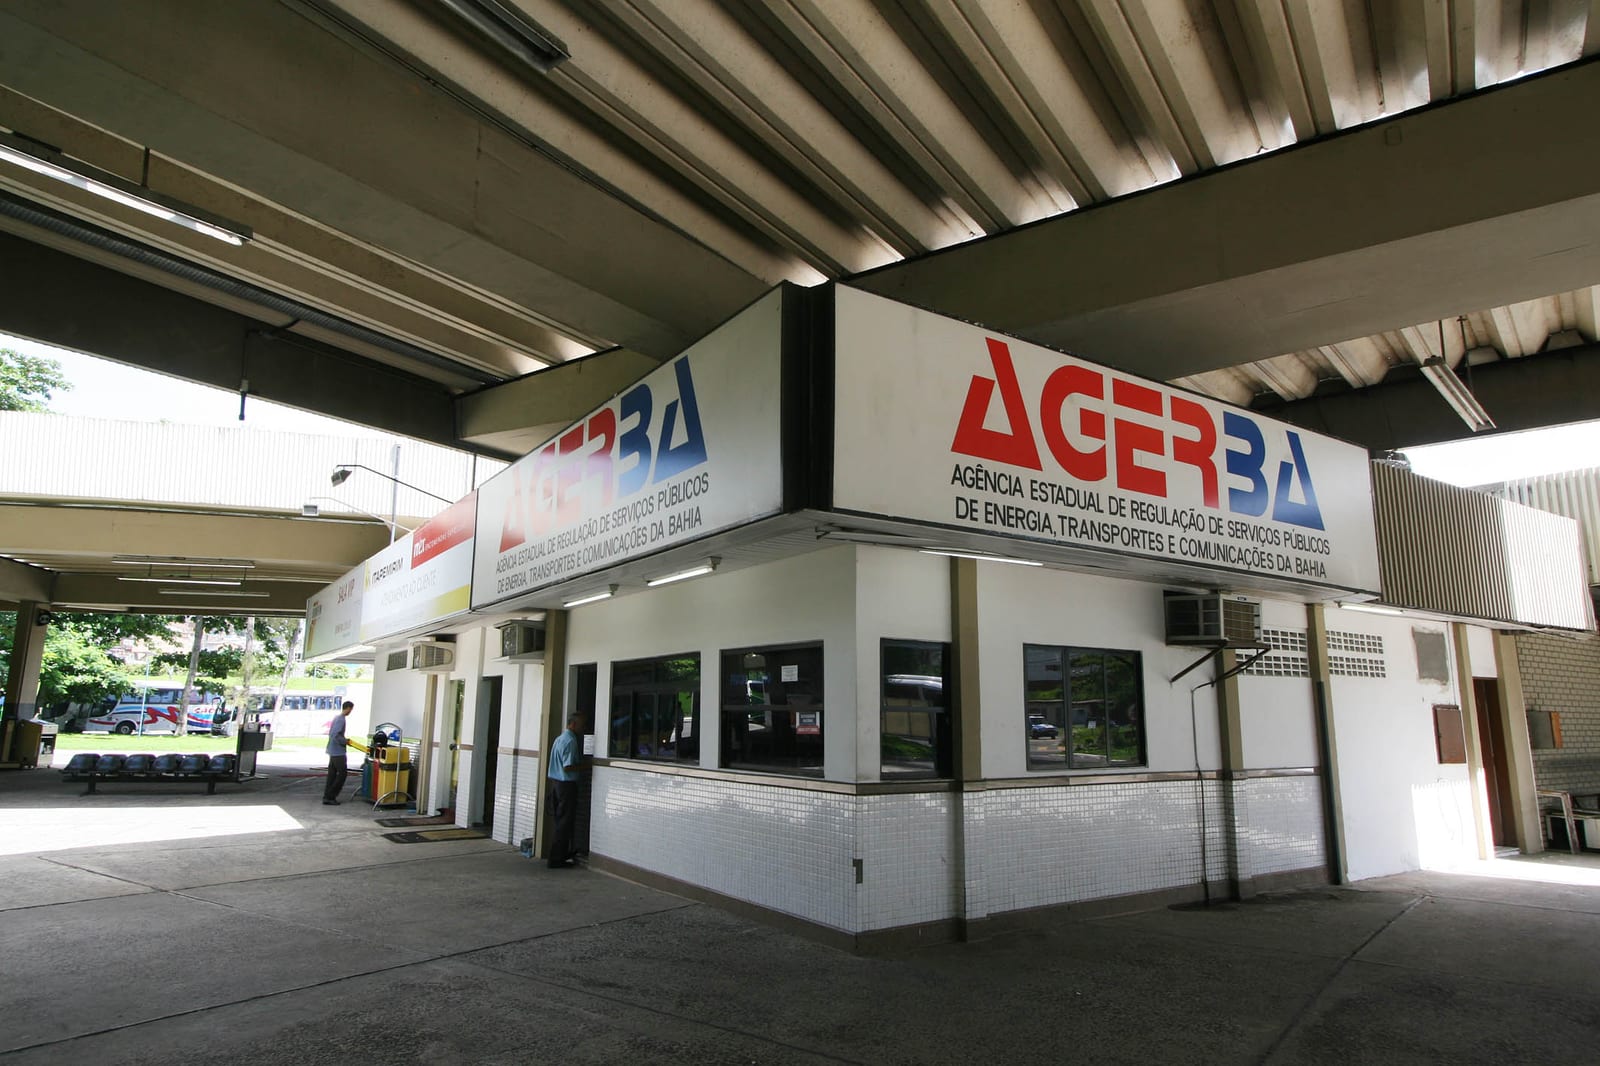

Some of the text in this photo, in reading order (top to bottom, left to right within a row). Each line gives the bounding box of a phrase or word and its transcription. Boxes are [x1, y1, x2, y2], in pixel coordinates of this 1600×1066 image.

[499, 355, 707, 553] AGERBA
[951, 337, 1325, 531] AGERBA
[496, 472, 709, 574] AGÊNCIA ESTADUAL DE REGULAÇÃO DE SERVIÇOS PÚBLICOS
[497, 578, 504, 594] DE
[530, 544, 575, 584] TRANSPORTES
[577, 551, 582, 568] E
[583, 522, 647, 562] COMUNICAÇÕES
[650, 518, 664, 542] DA
[668, 506, 702, 537] BAHIA
[951, 464, 1330, 556] AGÊNCIA ESTADUAL DE REGULAÇÃO DE SERVIÇOS PÚBLICOS
[956, 497, 1327, 579] DE ENERGIA, TRANSPORTES E COMUNICAÇÕES DA BAHIA
